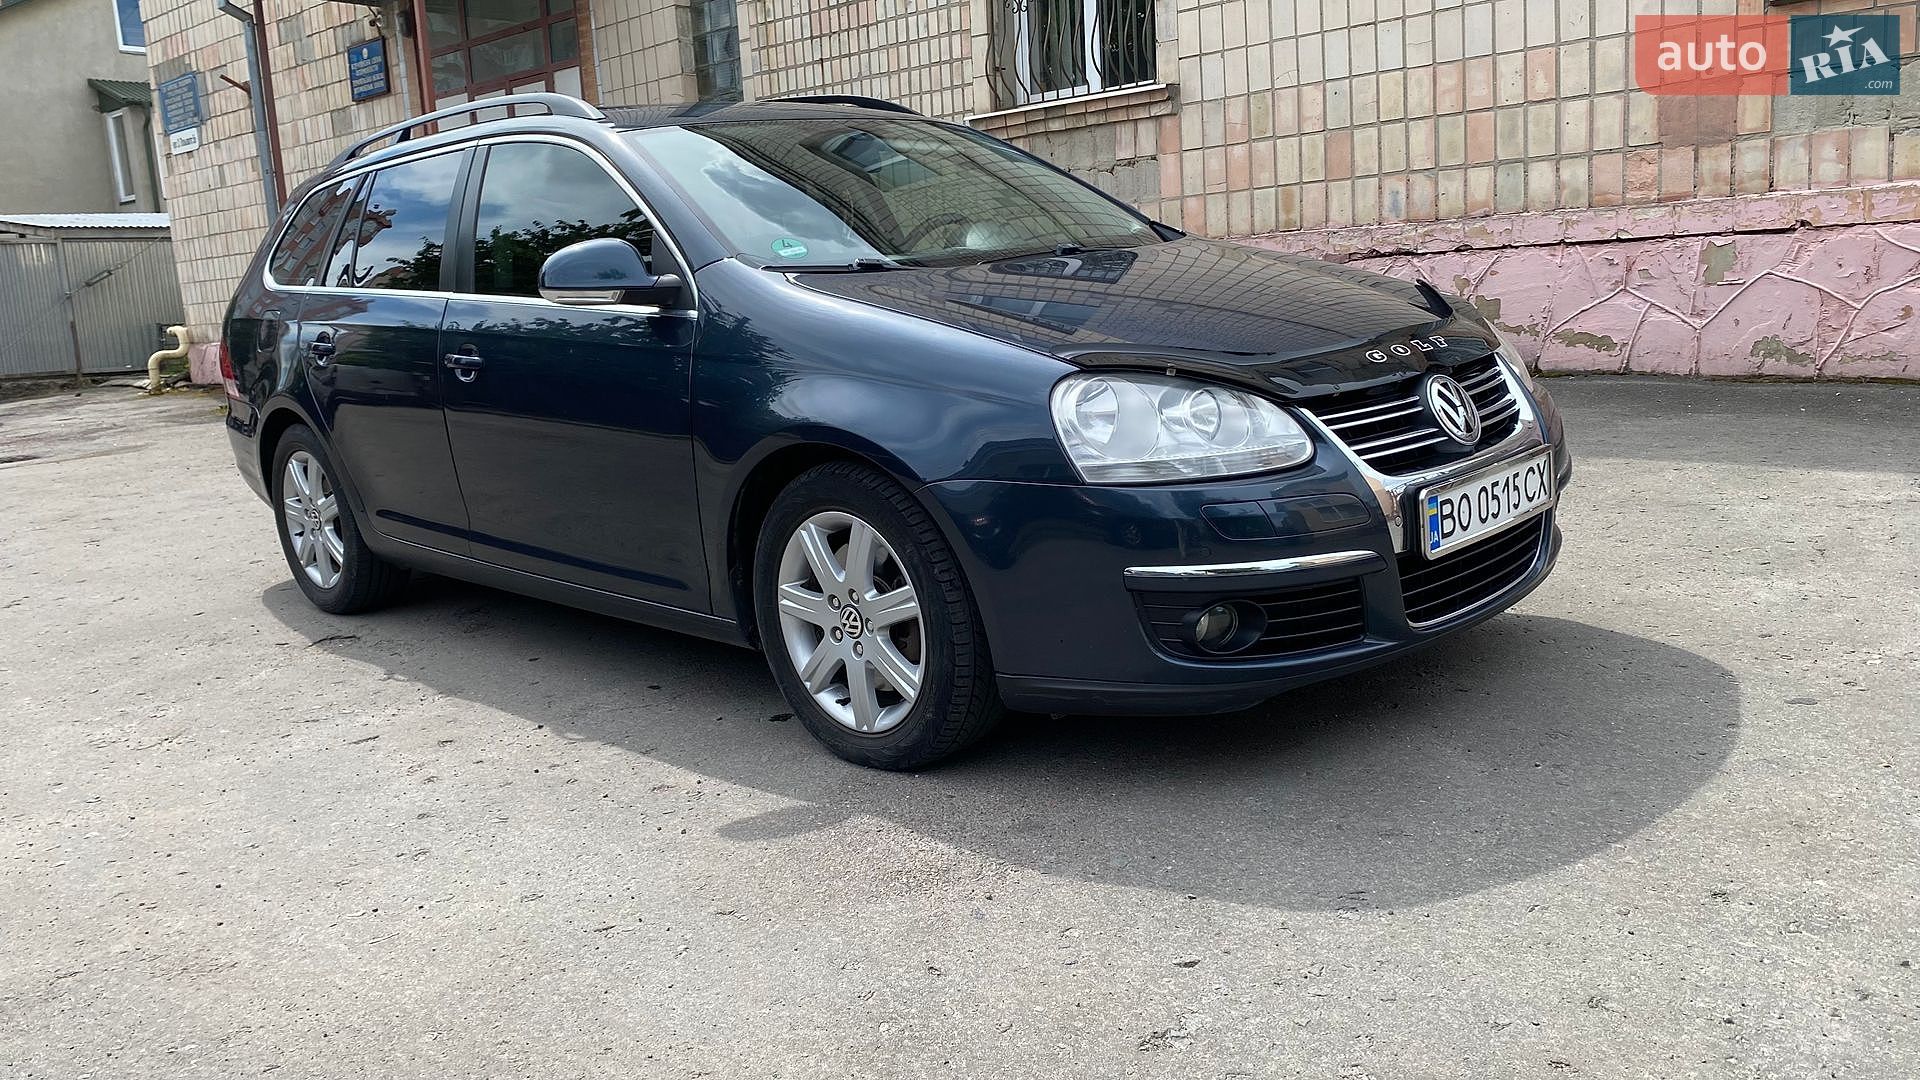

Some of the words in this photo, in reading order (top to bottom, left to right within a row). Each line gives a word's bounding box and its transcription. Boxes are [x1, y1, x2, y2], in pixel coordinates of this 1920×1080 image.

[1365, 335, 1448, 363] GOLF
[1439, 492, 1472, 540] BO
[1477, 471, 1521, 524] 0515
[1524, 459, 1548, 502] CX
